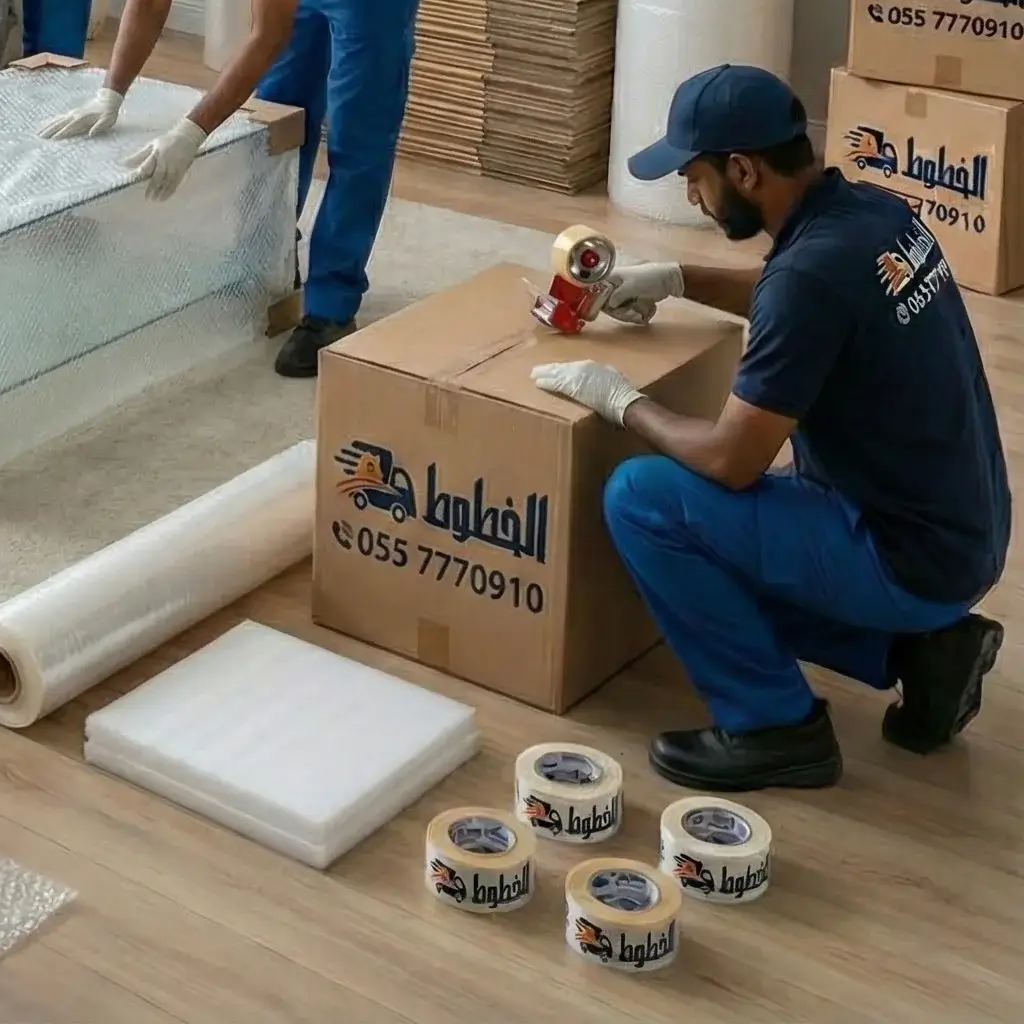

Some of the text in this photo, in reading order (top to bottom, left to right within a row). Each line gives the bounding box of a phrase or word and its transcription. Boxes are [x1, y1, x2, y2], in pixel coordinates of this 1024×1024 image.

[887, 6, 1024, 41] 055 7770910
[901, 136, 988, 201] الخطوط
[422, 462, 549, 565] الخطوط
[357, 527, 544, 614] 055 7770910
